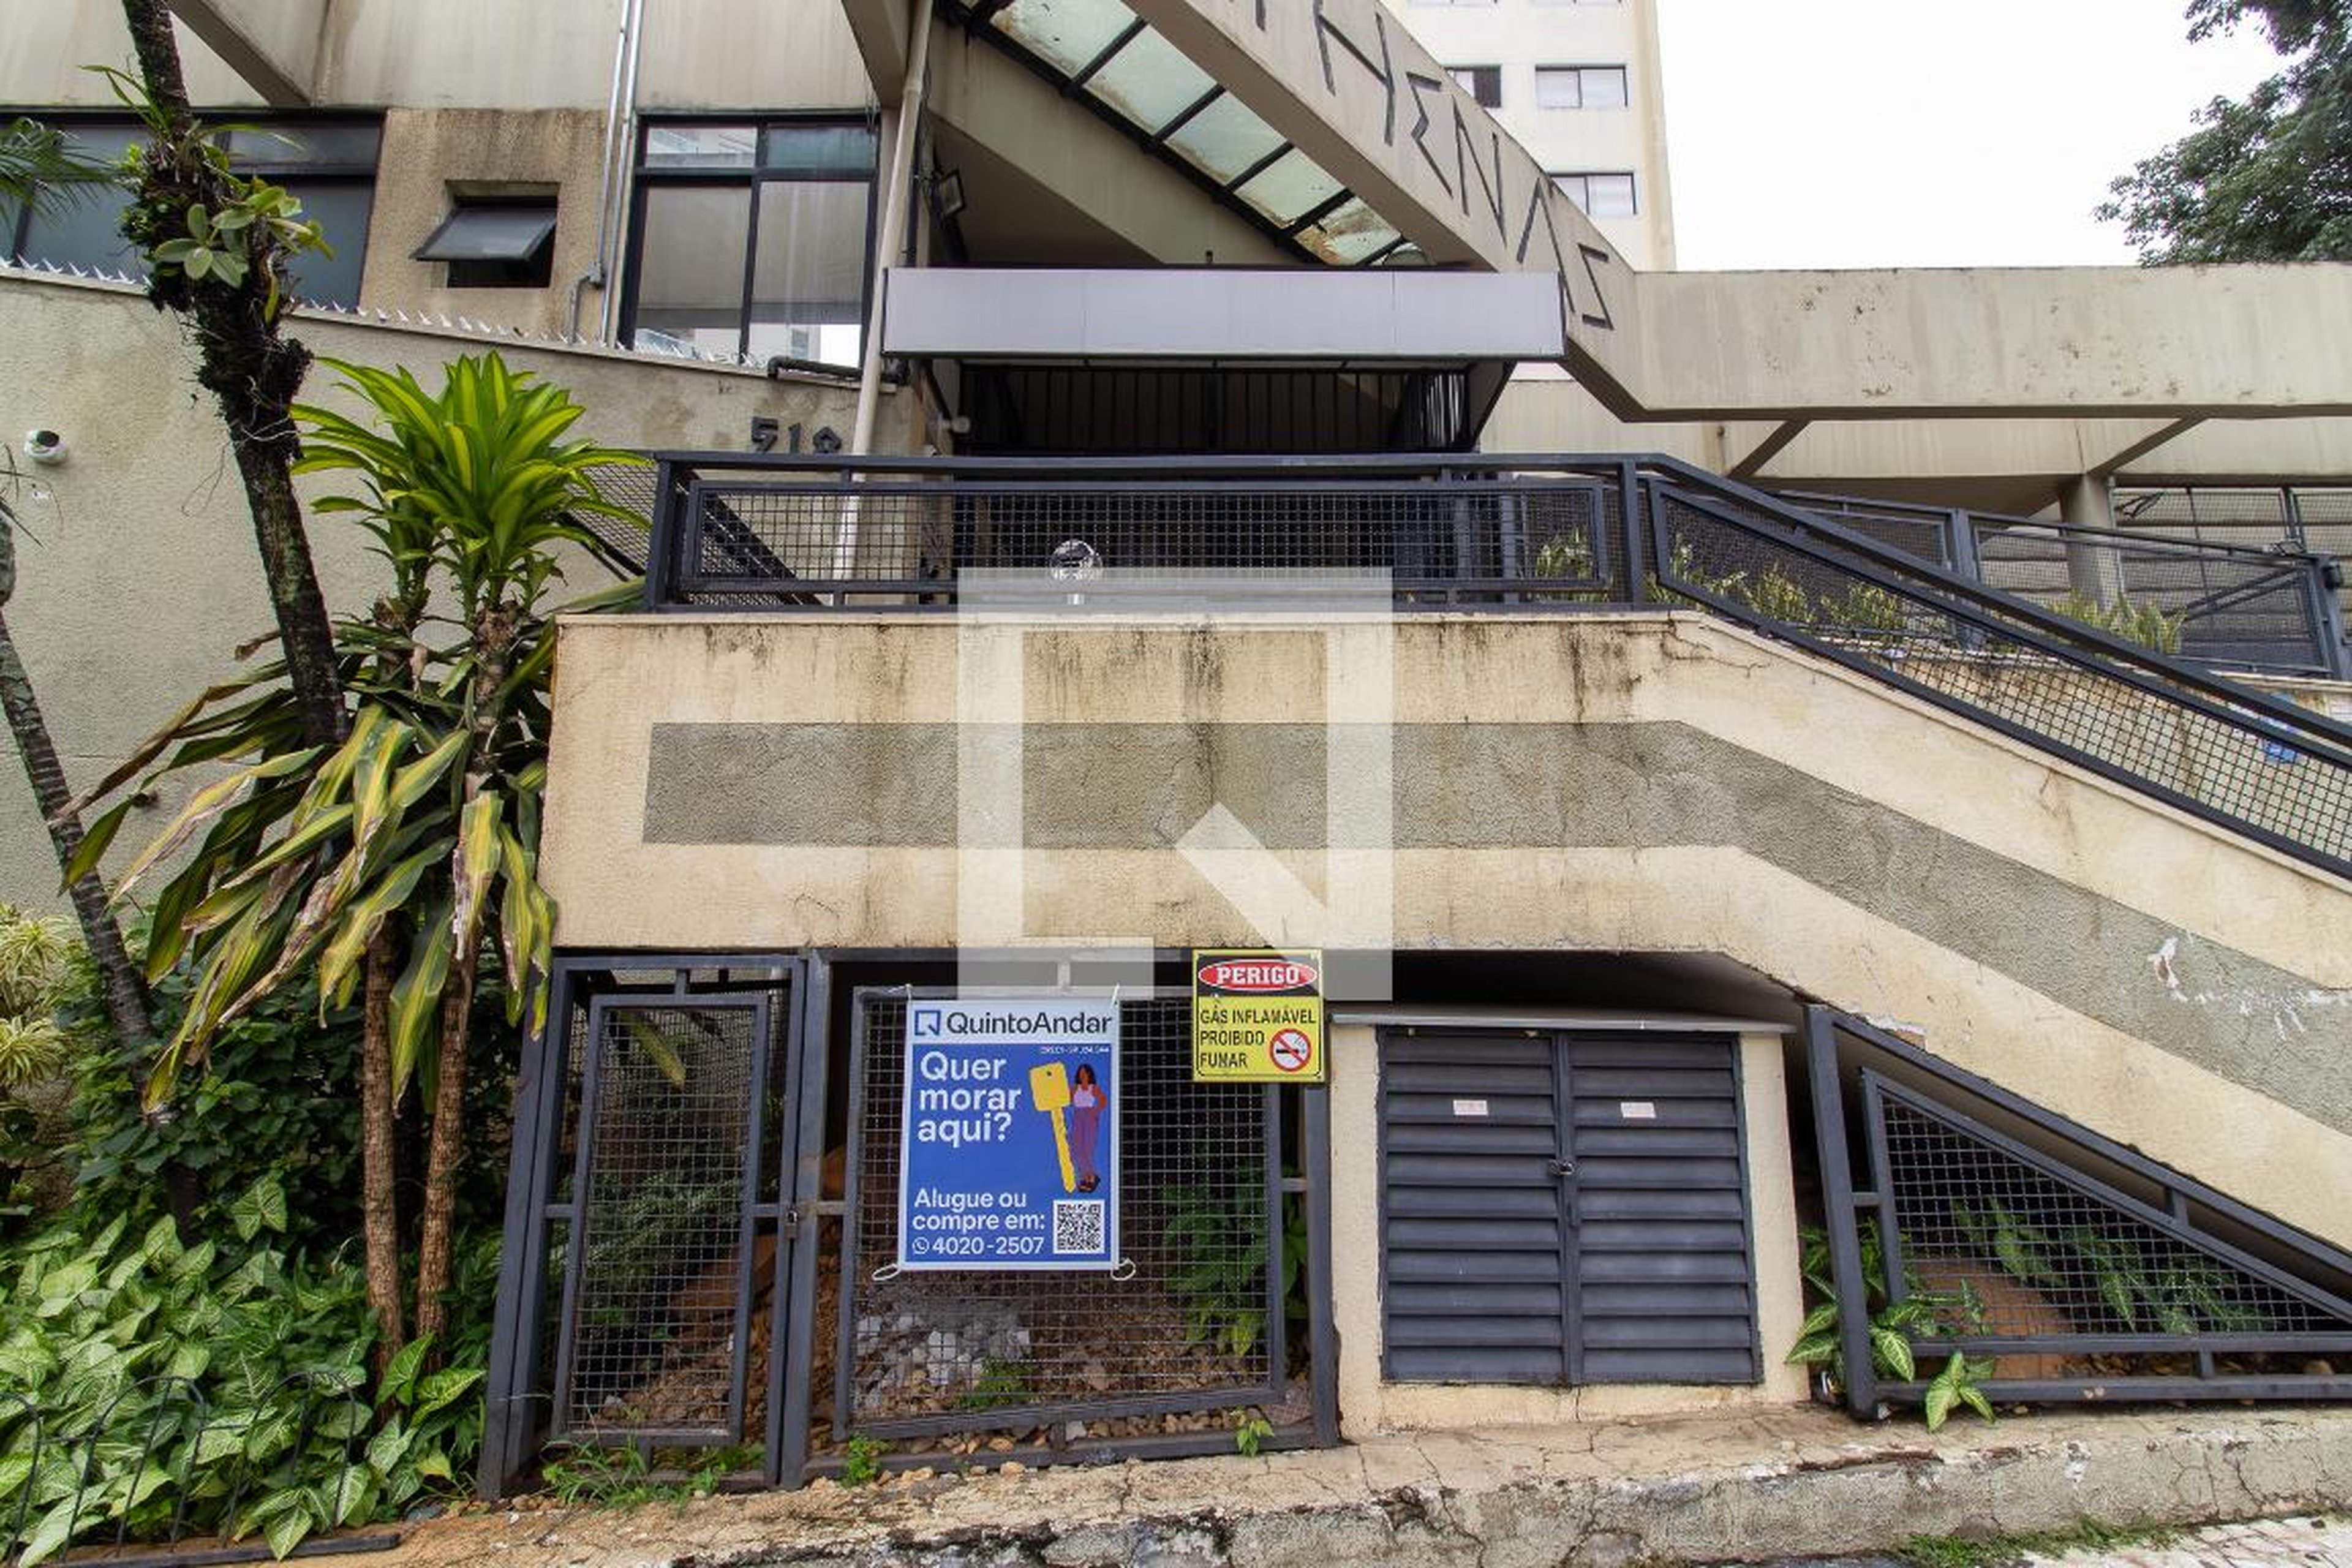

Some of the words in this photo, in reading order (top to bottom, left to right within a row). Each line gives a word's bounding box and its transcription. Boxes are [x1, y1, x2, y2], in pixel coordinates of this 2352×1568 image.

[1216, 966, 1300, 984] PERIGO
[946, 1012, 1112, 1035] QuintoAndar
[1200, 1030, 1265, 1046] PROIBIDO
[919, 1050, 1007, 1080] Quer
[1200, 1053, 1248, 1068] FUMAR
[919, 1087, 1022, 1111] morar
[918, 1112, 1012, 1148] aqui?
[914, 1188, 993, 1213] Alugue
[999, 1192, 1027, 1208] ou
[912, 1214, 1000, 1234] compre
[1004, 1215, 1046, 1231] em:
[932, 1237, 1044, 1255] 4020-2507
